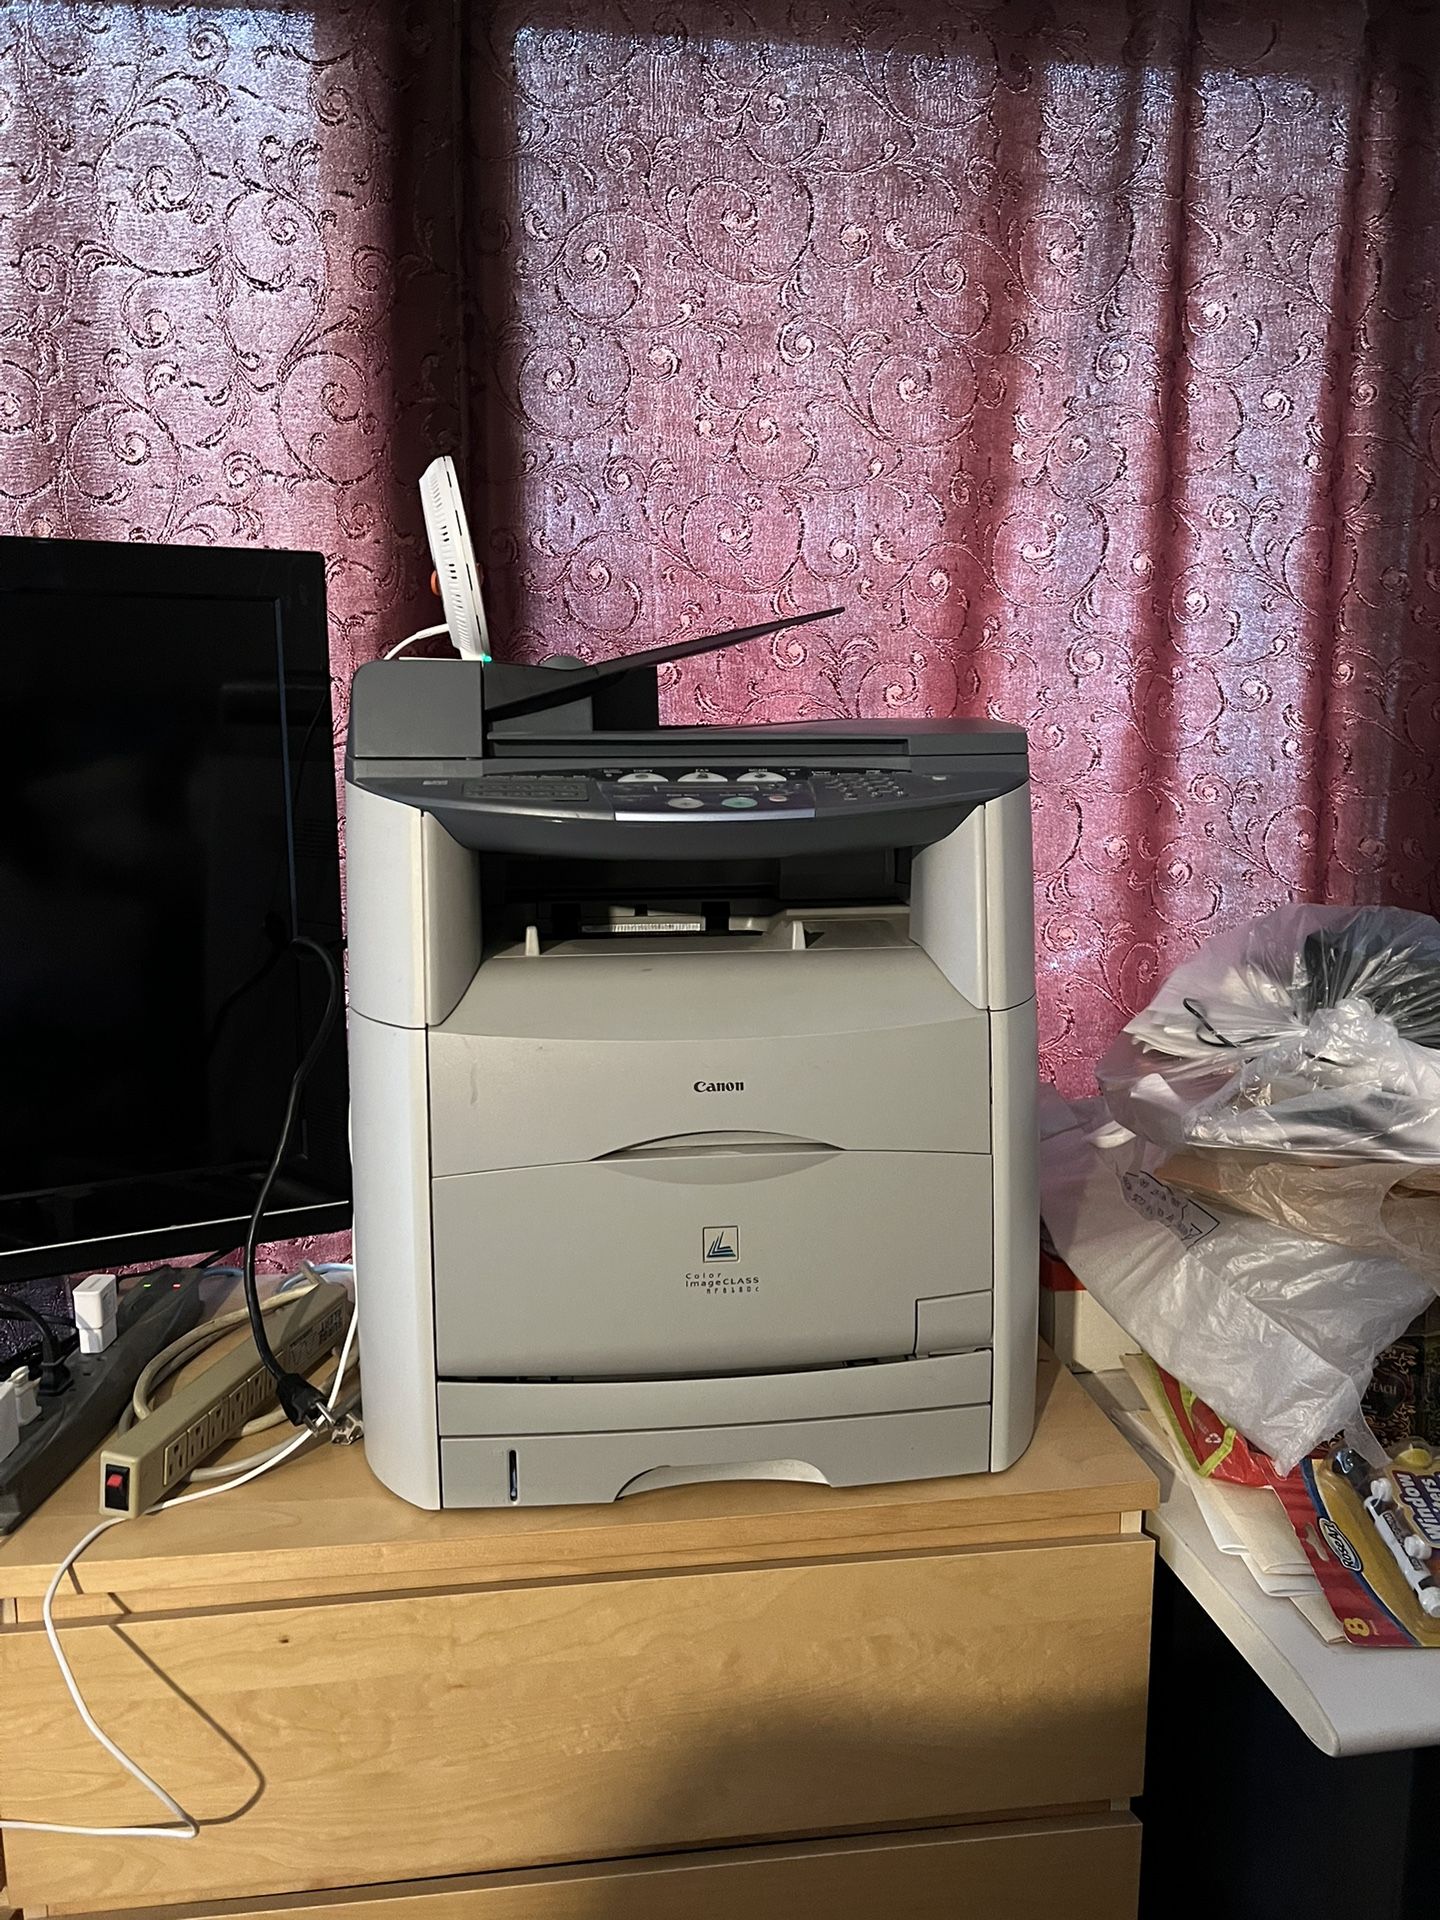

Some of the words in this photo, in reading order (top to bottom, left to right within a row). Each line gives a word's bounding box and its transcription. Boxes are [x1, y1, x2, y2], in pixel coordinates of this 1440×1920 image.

[693, 1081, 745, 1093] Canon
[685, 1272, 721, 1280] Color
[1396, 1473, 1440, 1540] Window
[1324, 1520, 1355, 1568] RoseArt
[1343, 1618, 1370, 1637] 8
